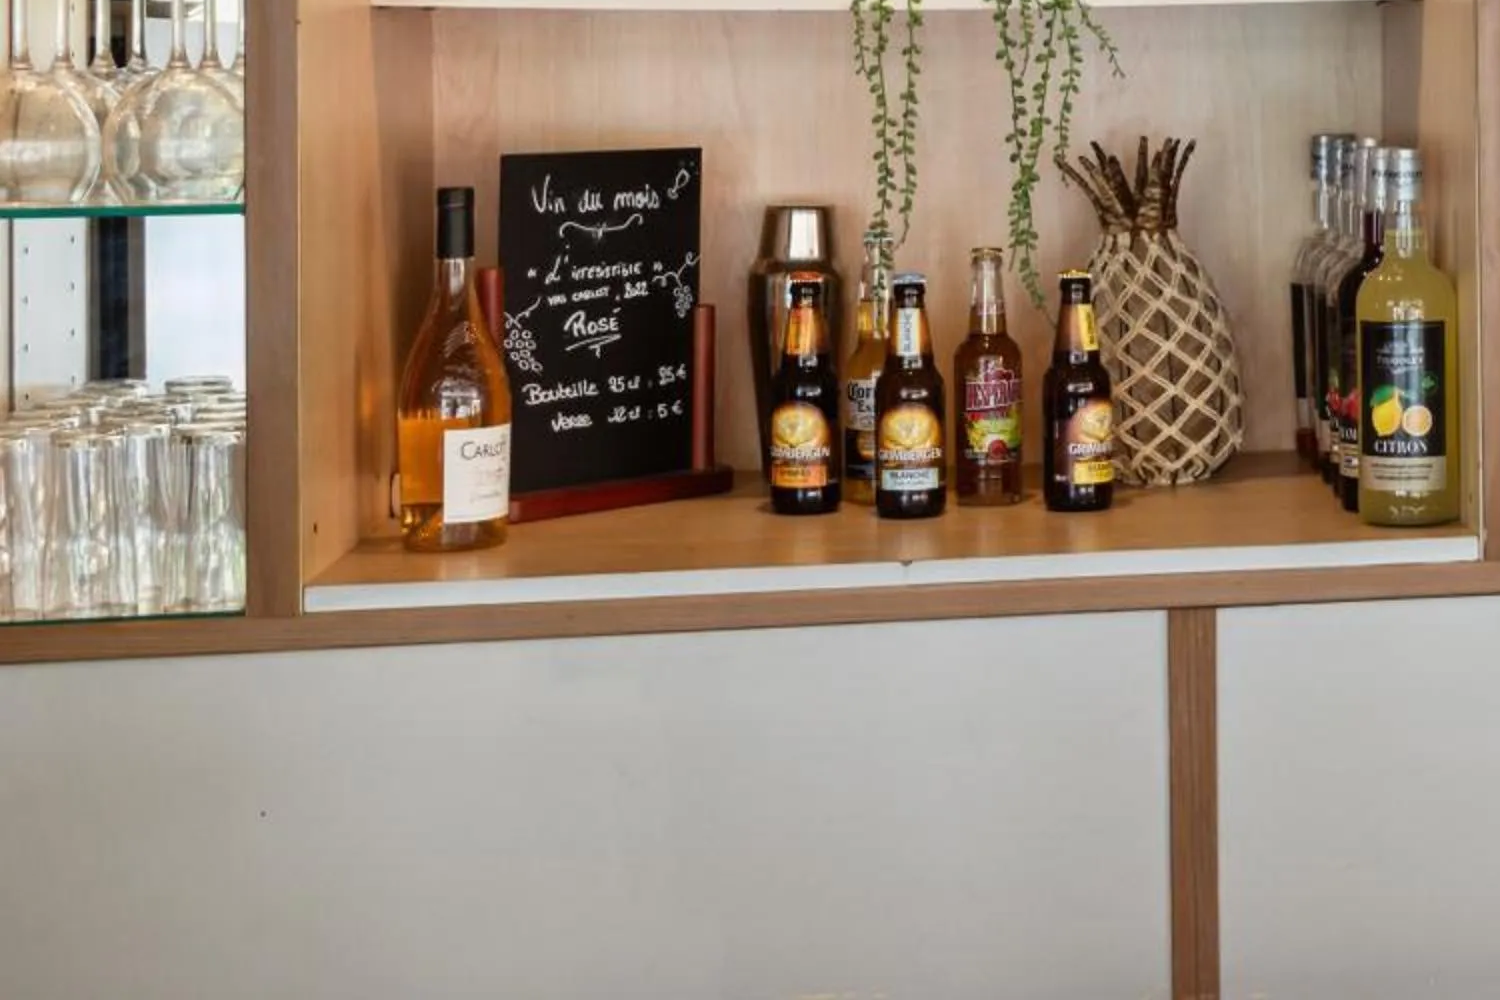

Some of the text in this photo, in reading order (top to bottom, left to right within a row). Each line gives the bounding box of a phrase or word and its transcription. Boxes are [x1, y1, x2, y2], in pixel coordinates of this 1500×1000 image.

[531, 174, 661, 214] Vin du mois
[1374, 439, 1428, 454] CITRON
